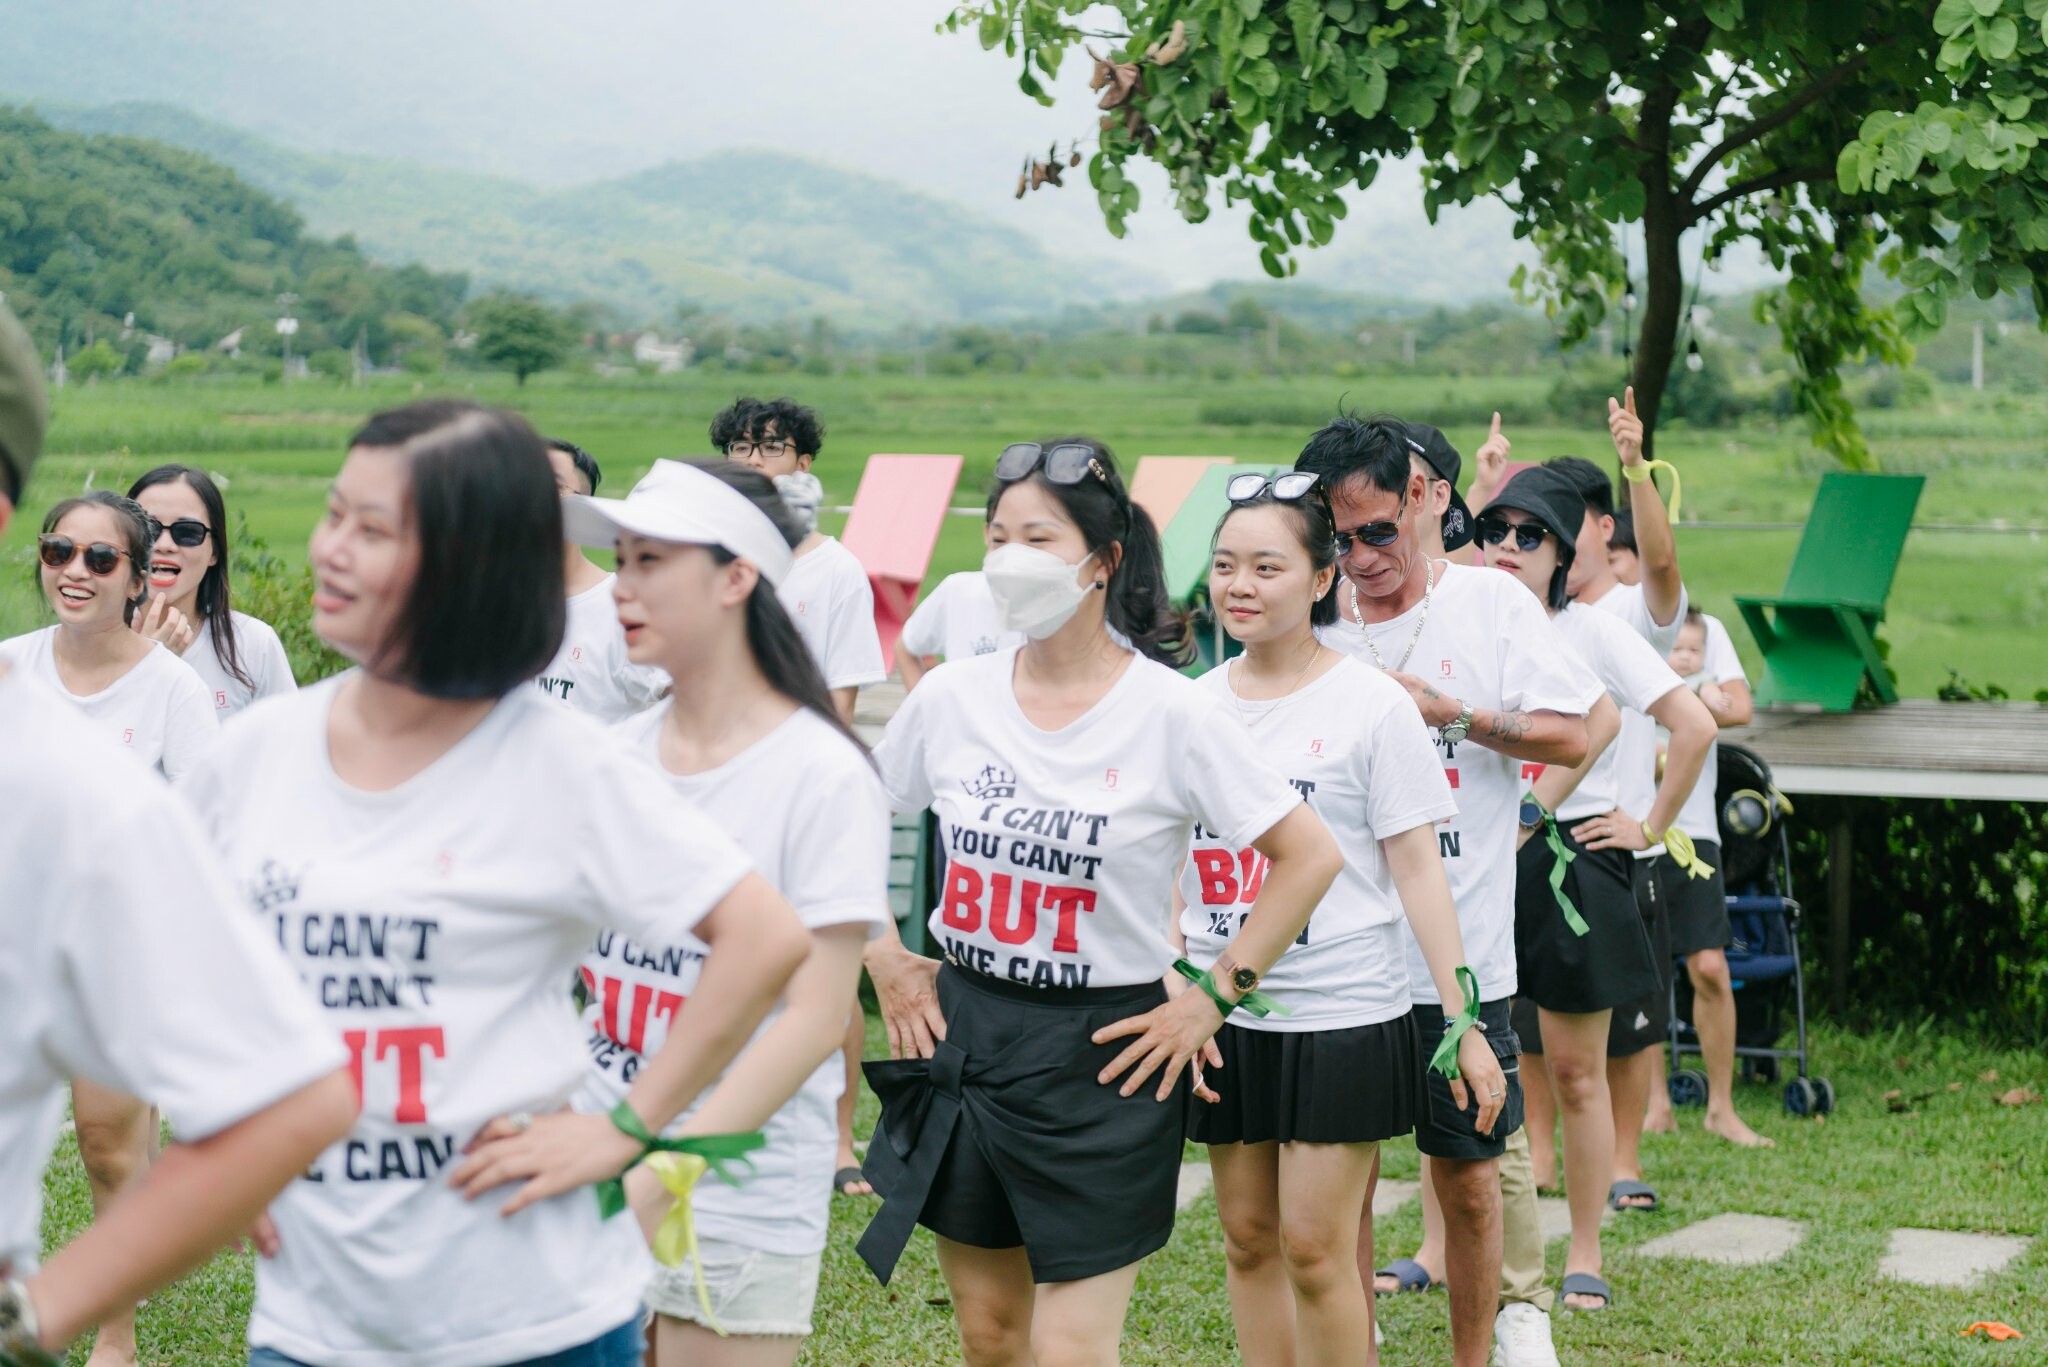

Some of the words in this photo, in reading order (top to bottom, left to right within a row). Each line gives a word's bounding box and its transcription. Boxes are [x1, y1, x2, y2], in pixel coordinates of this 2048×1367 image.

[1002, 807, 1109, 847] CAN'T
[951, 824, 1001, 860] YOU
[1009, 840, 1102, 881] CAN'T
[1192, 847, 1273, 905] BU
[942, 858, 1097, 954] BUT
[303, 914, 439, 961] CAN'T
[321, 974, 434, 1008] CANT
[1007, 955, 1092, 988] CAN
[346, 1132, 455, 1182] CAN
